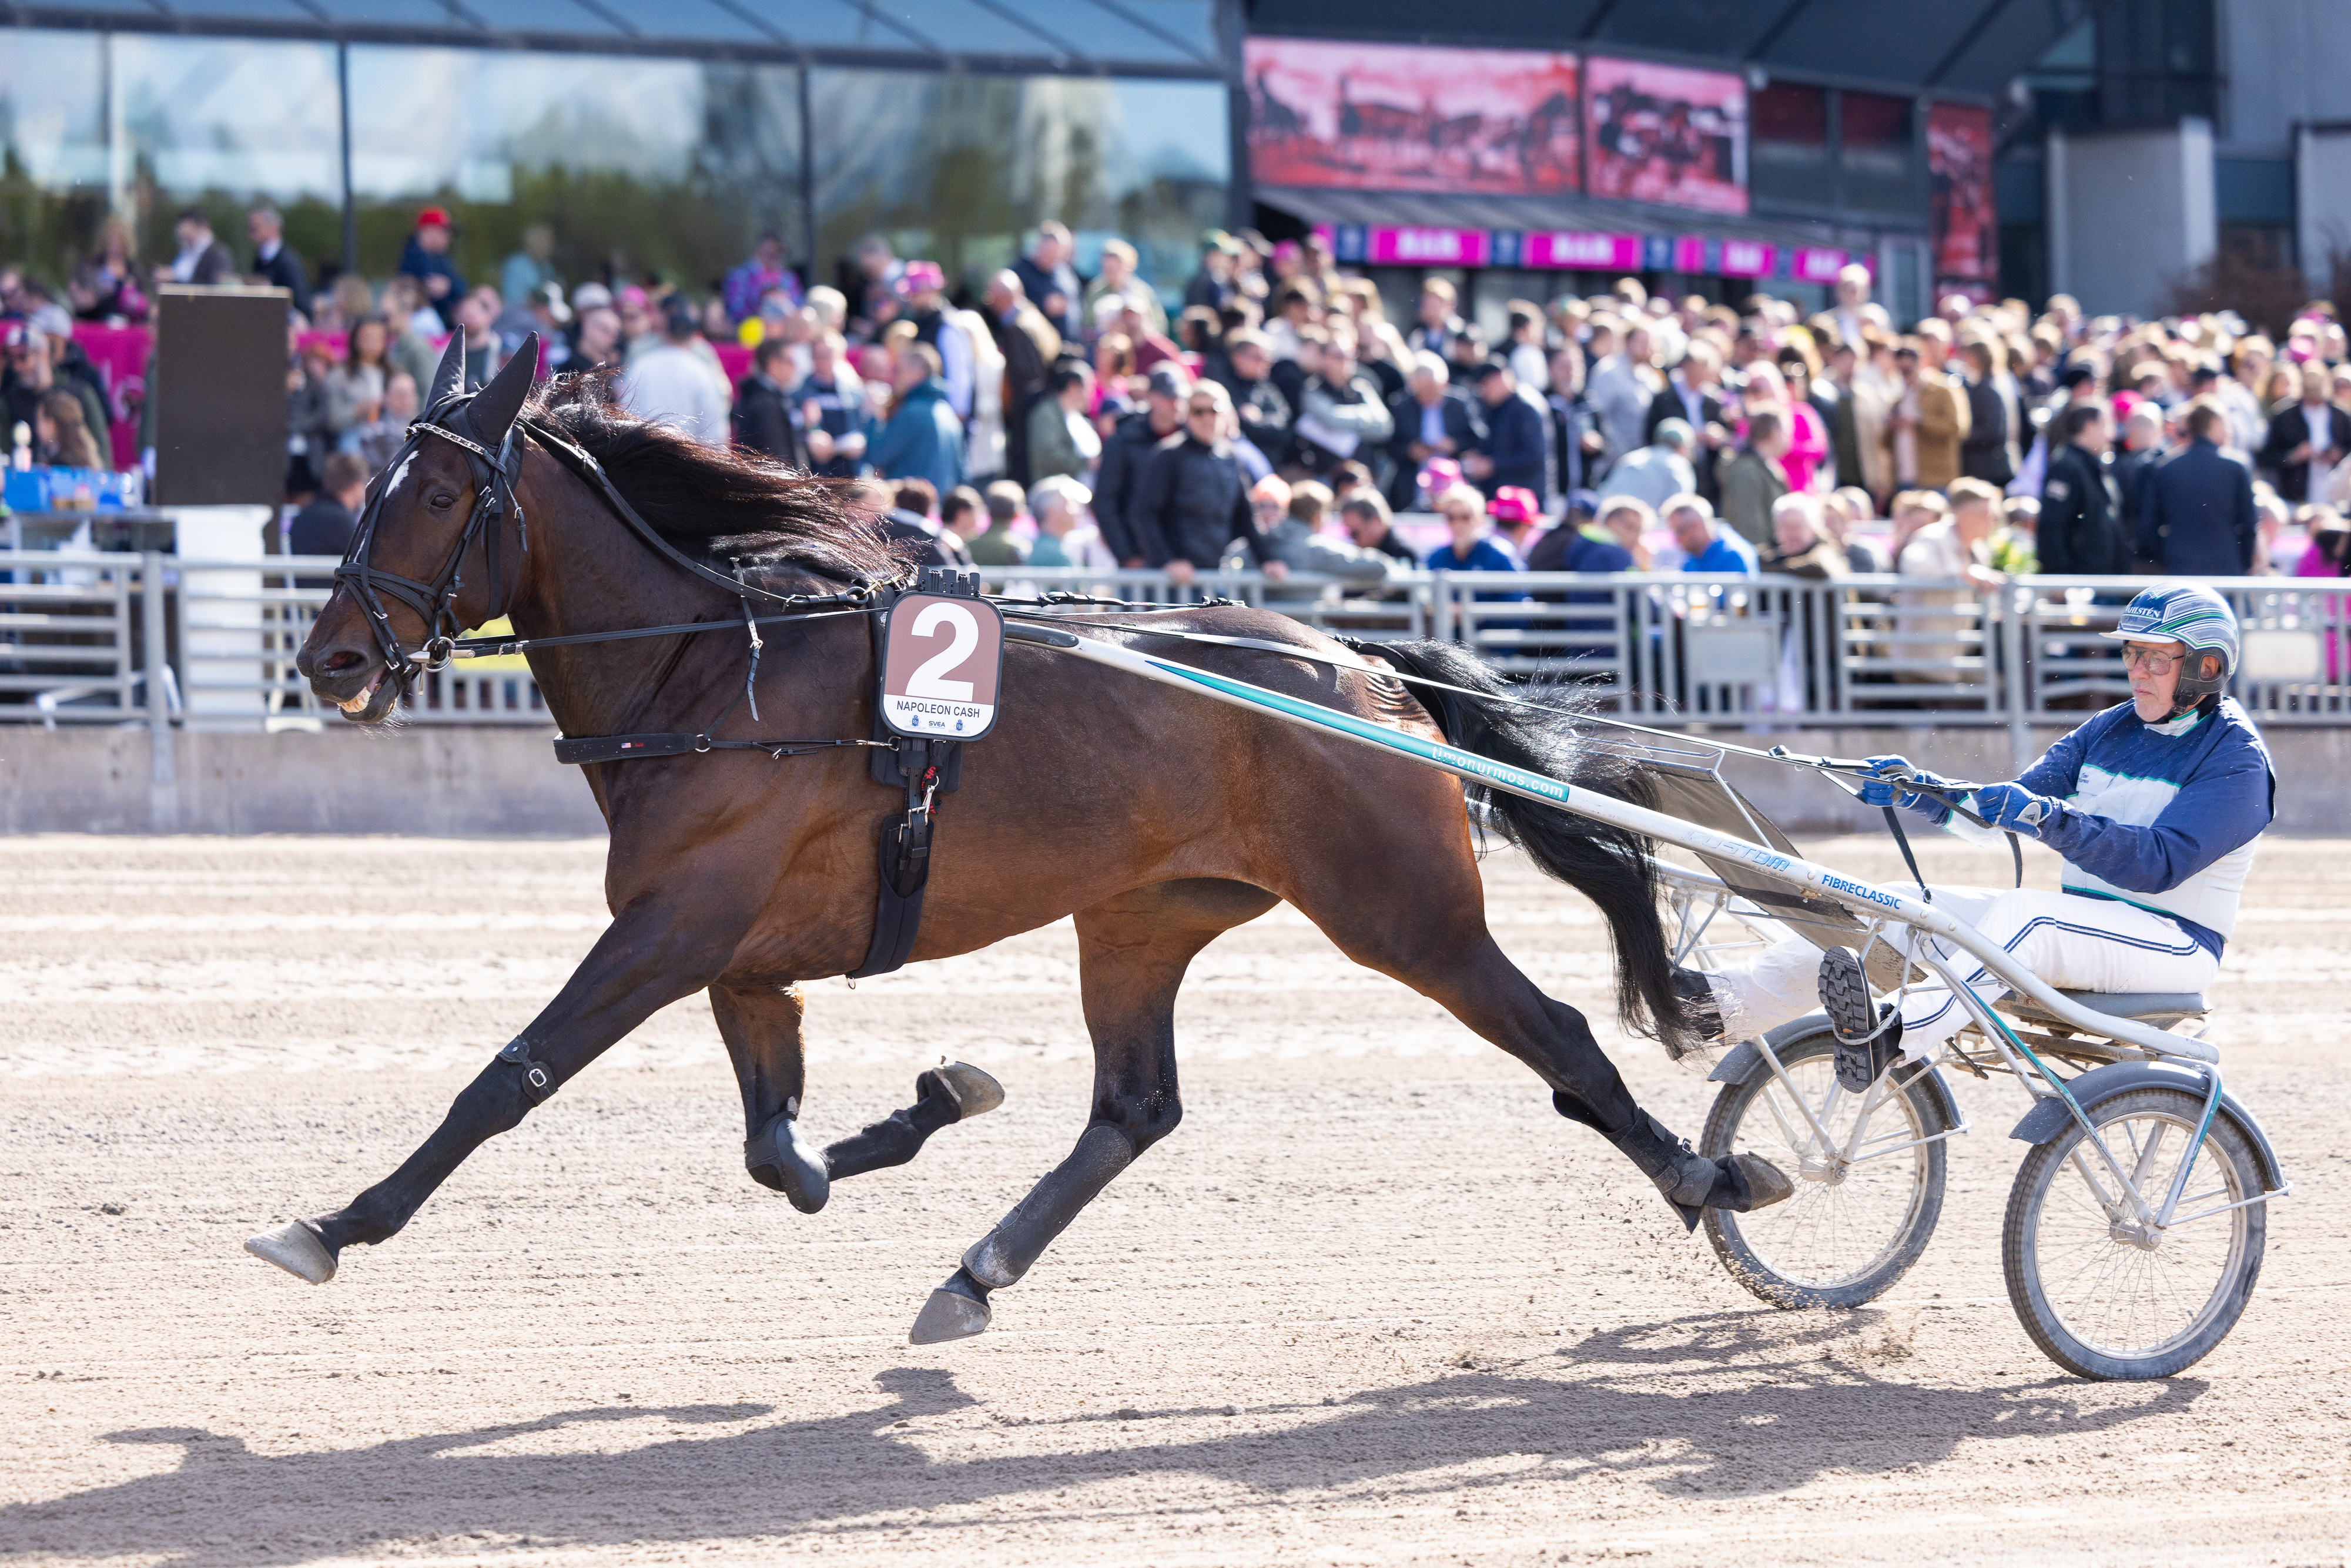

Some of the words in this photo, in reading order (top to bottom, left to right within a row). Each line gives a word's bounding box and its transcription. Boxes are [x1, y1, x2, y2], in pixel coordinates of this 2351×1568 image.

[905, 602, 979, 702] 2
[897, 701, 950, 715] NAPOLEON
[954, 706, 980, 718] CASH
[1432, 746, 1563, 798] timonurmos.com
[1821, 874, 1903, 909] FIBRECLASSIC
